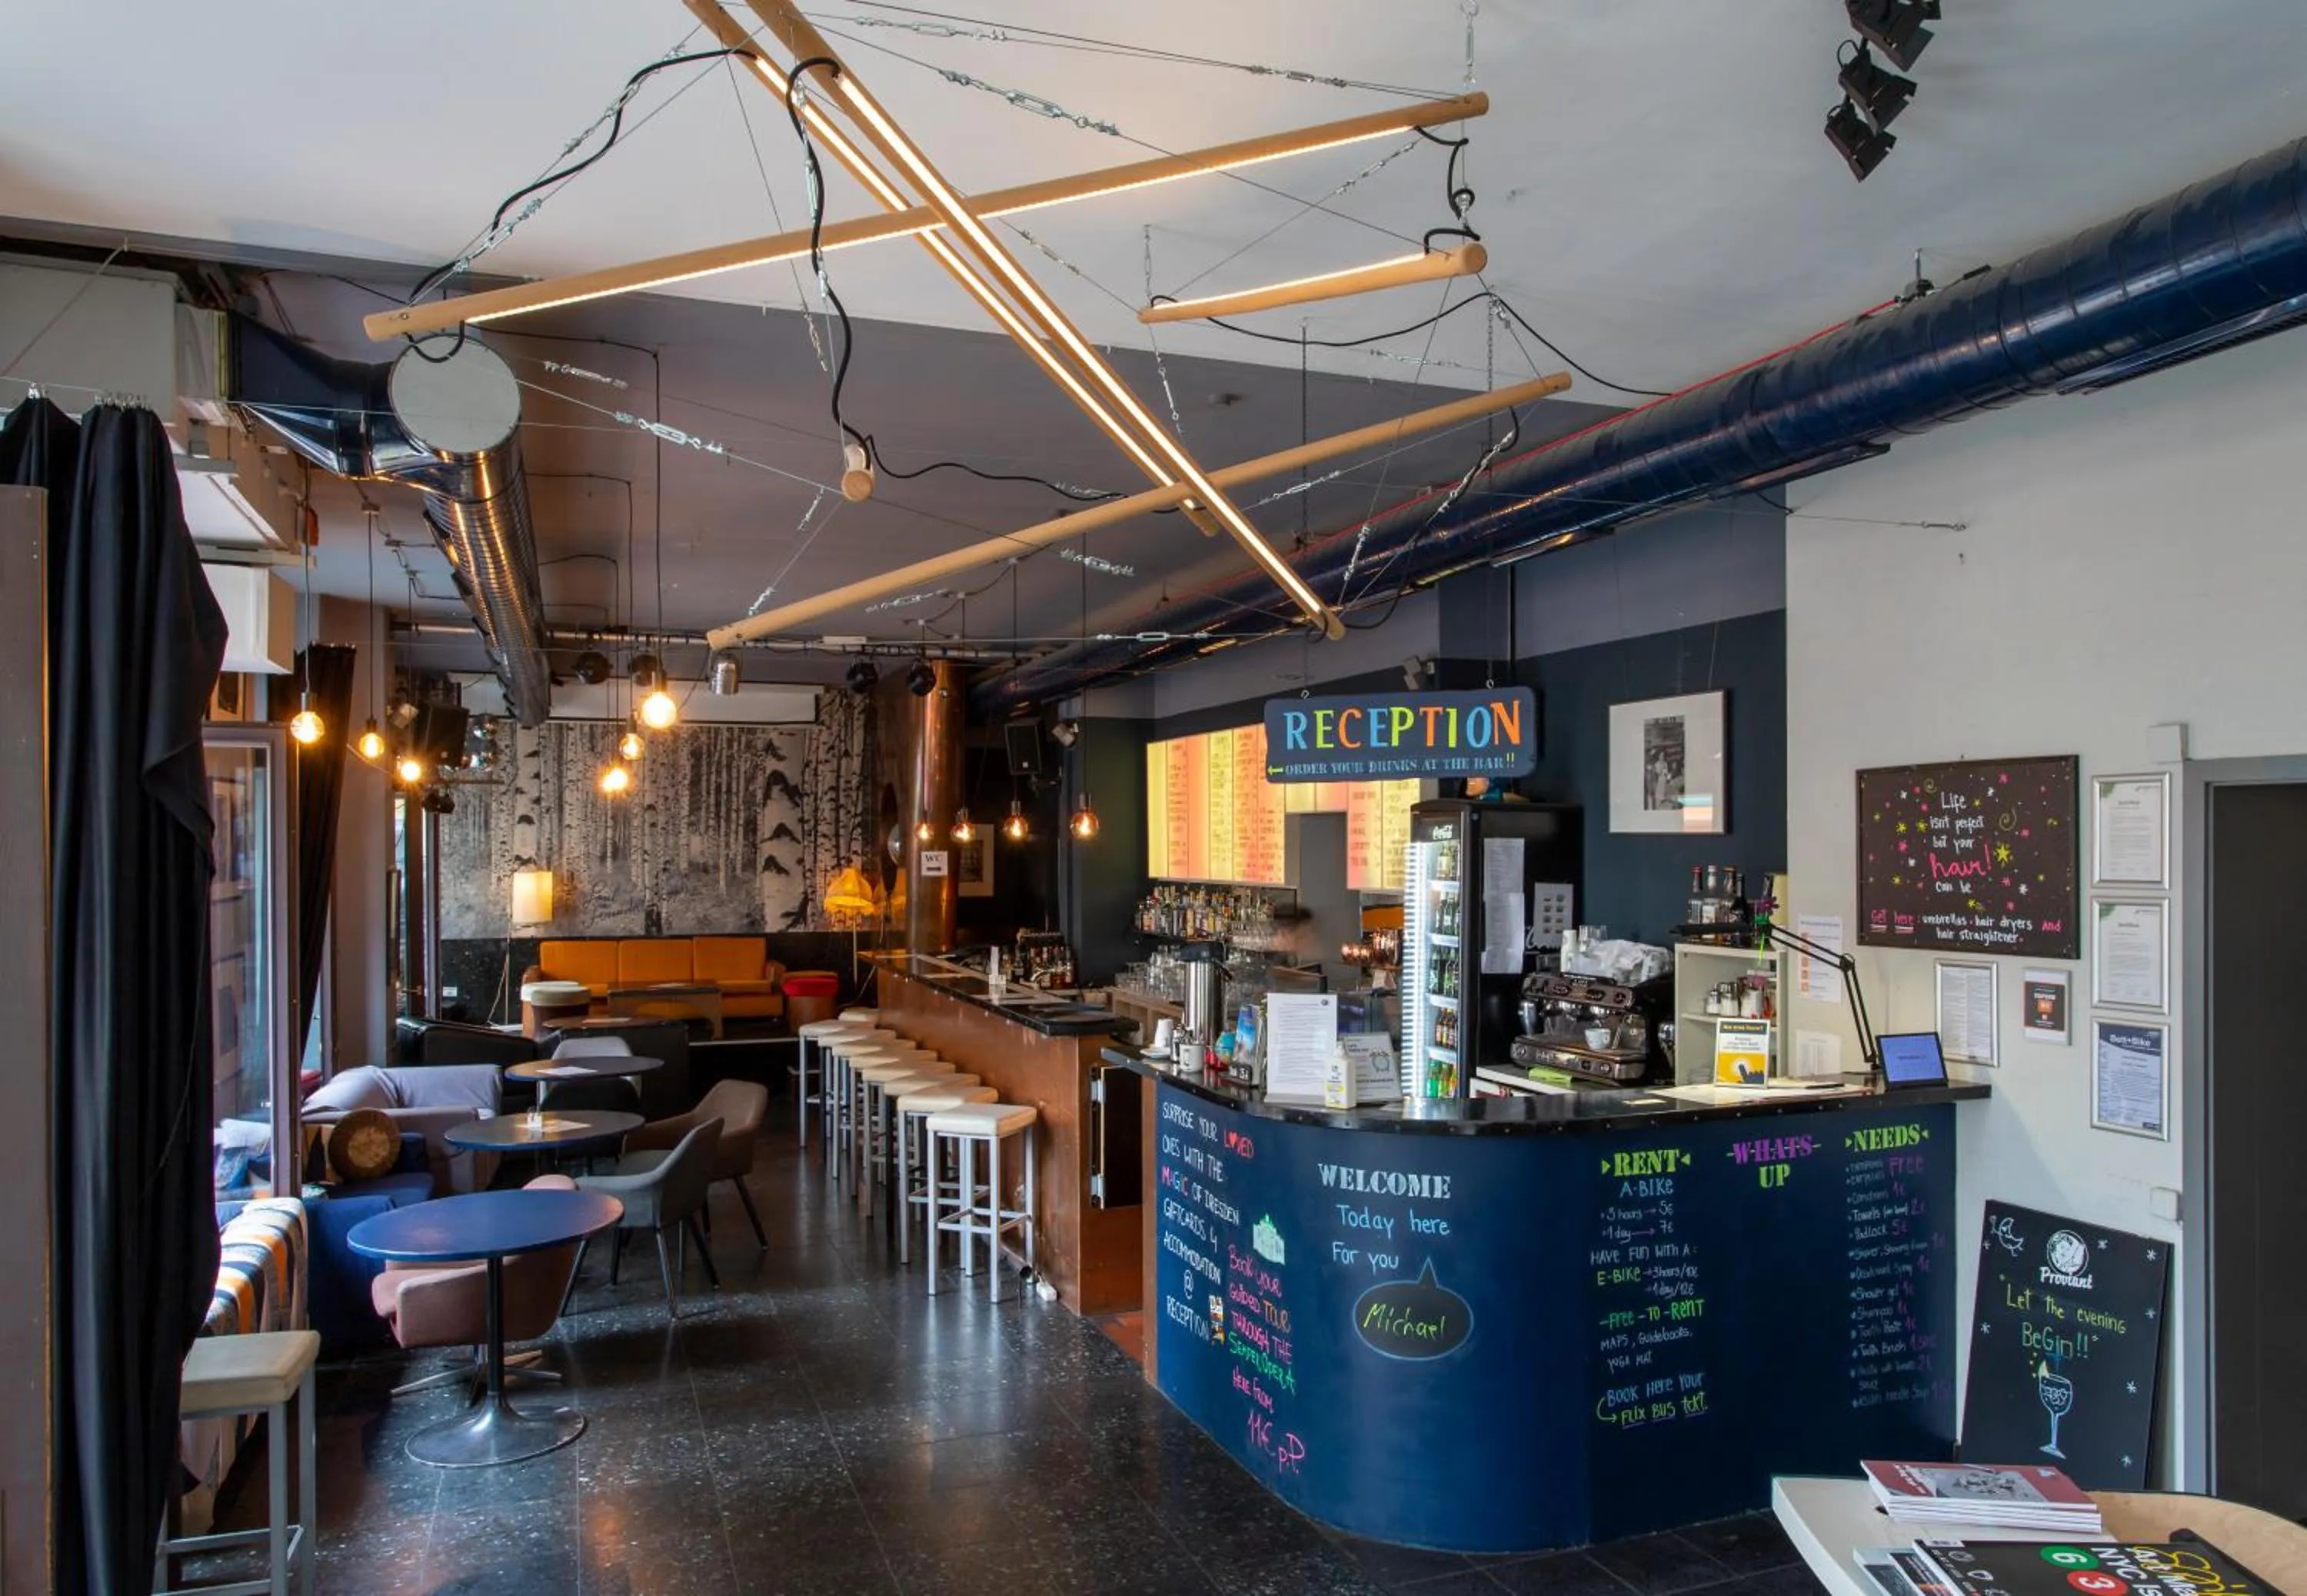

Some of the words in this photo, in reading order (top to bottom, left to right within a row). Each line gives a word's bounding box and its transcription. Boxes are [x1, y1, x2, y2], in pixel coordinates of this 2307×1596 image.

[1283, 700, 1521, 750] RECEPTION
[1285, 762, 1327, 776] ORDER
[1331, 760, 1363, 774] YOUR
[1369, 759, 1417, 773] DRINKS
[1423, 759, 1437, 770] AT
[1442, 757, 1470, 770] THE
[1853, 1123, 1920, 1152] NEEDS
[1183, 1144, 1203, 1172] WITH
[1207, 1153, 1223, 1182] THE
[1613, 1149, 1679, 1177] RENT
[1759, 1163, 1791, 1189] UP
[1317, 1163, 1451, 1199] WELCOME
[1336, 1204, 1394, 1239] Today
[1410, 1208, 1450, 1235] here
[1333, 1242, 1359, 1265] For
[1367, 1252, 1400, 1275] you
[2039, 1266, 2092, 1290] Proviant
[2006, 1282, 2032, 1311] Let
[1363, 1303, 1446, 1341] Michael
[2091, 1547, 2149, 1580] NYC
